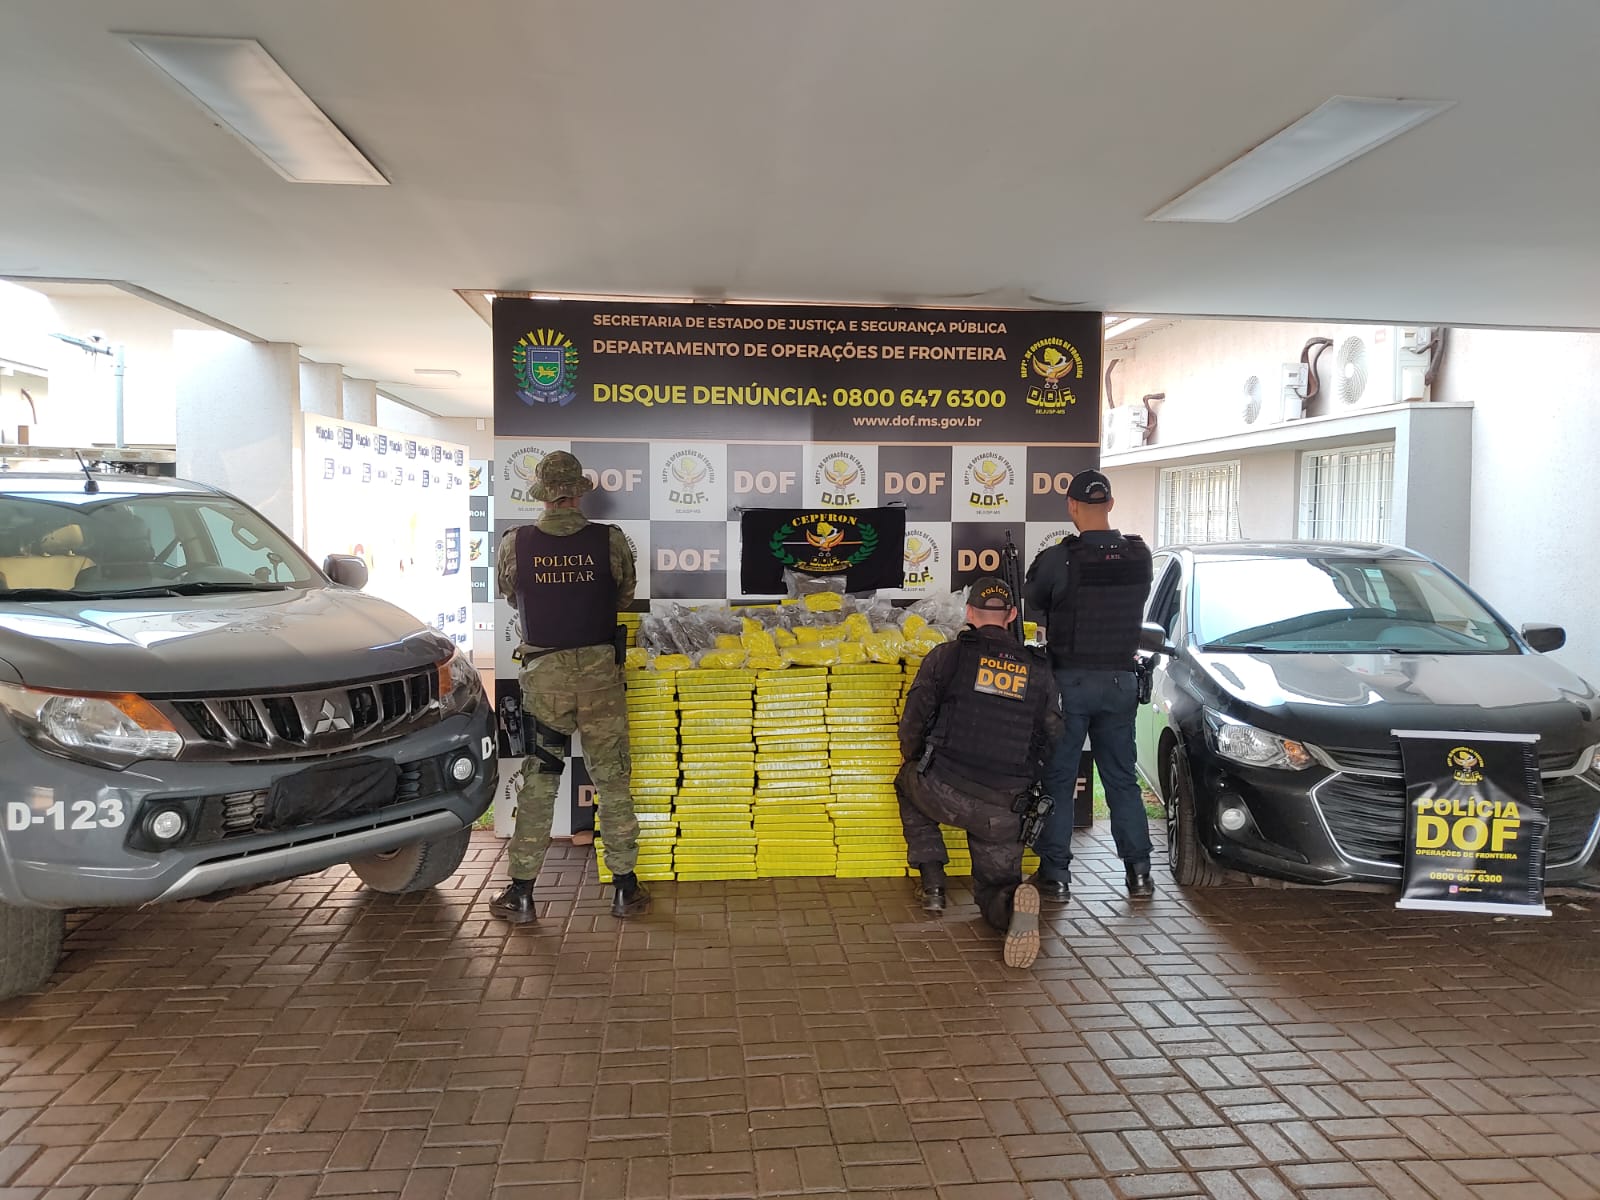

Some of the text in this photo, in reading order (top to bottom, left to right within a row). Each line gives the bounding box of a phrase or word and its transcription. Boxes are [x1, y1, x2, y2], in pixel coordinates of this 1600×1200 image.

[593, 314, 1007, 335] SECRETARIA DE ESTADO DE JUSTIÇA E SEGURANÇA PÚBLICA
[593, 339, 1007, 362] DEPARTAMENTO DE OPERAÇÕES DE FRONTEIRA
[593, 384, 686, 407] DISQUE
[693, 382, 828, 407] DENÚNCIA:
[832, 388, 895, 408] 0800
[900, 389, 942, 408] 647
[946, 389, 1007, 408] 6300
[853, 415, 982, 428] www.dof.ms.gov.br
[734, 471, 796, 493] DOF
[884, 472, 946, 494] DOF
[1033, 472, 1073, 494] DO
[970, 492, 1008, 505] D.O.F.
[792, 513, 857, 527] CEPFRON
[533, 554, 594, 568] POLICIA
[657, 549, 720, 571] DOF
[958, 549, 1000, 571] DO
[535, 571, 594, 583] MILITAR
[981, 585, 1009, 599] POLÍCIA
[980, 657, 1028, 675] POLÍCIA
[977, 668, 1027, 692] DOF
[7, 799, 125, 831] D-123
[1417, 796, 1520, 819] POLÍCIA
[1416, 816, 1521, 851] DOF
[1429, 872, 1502, 883] 0800 647 6300
